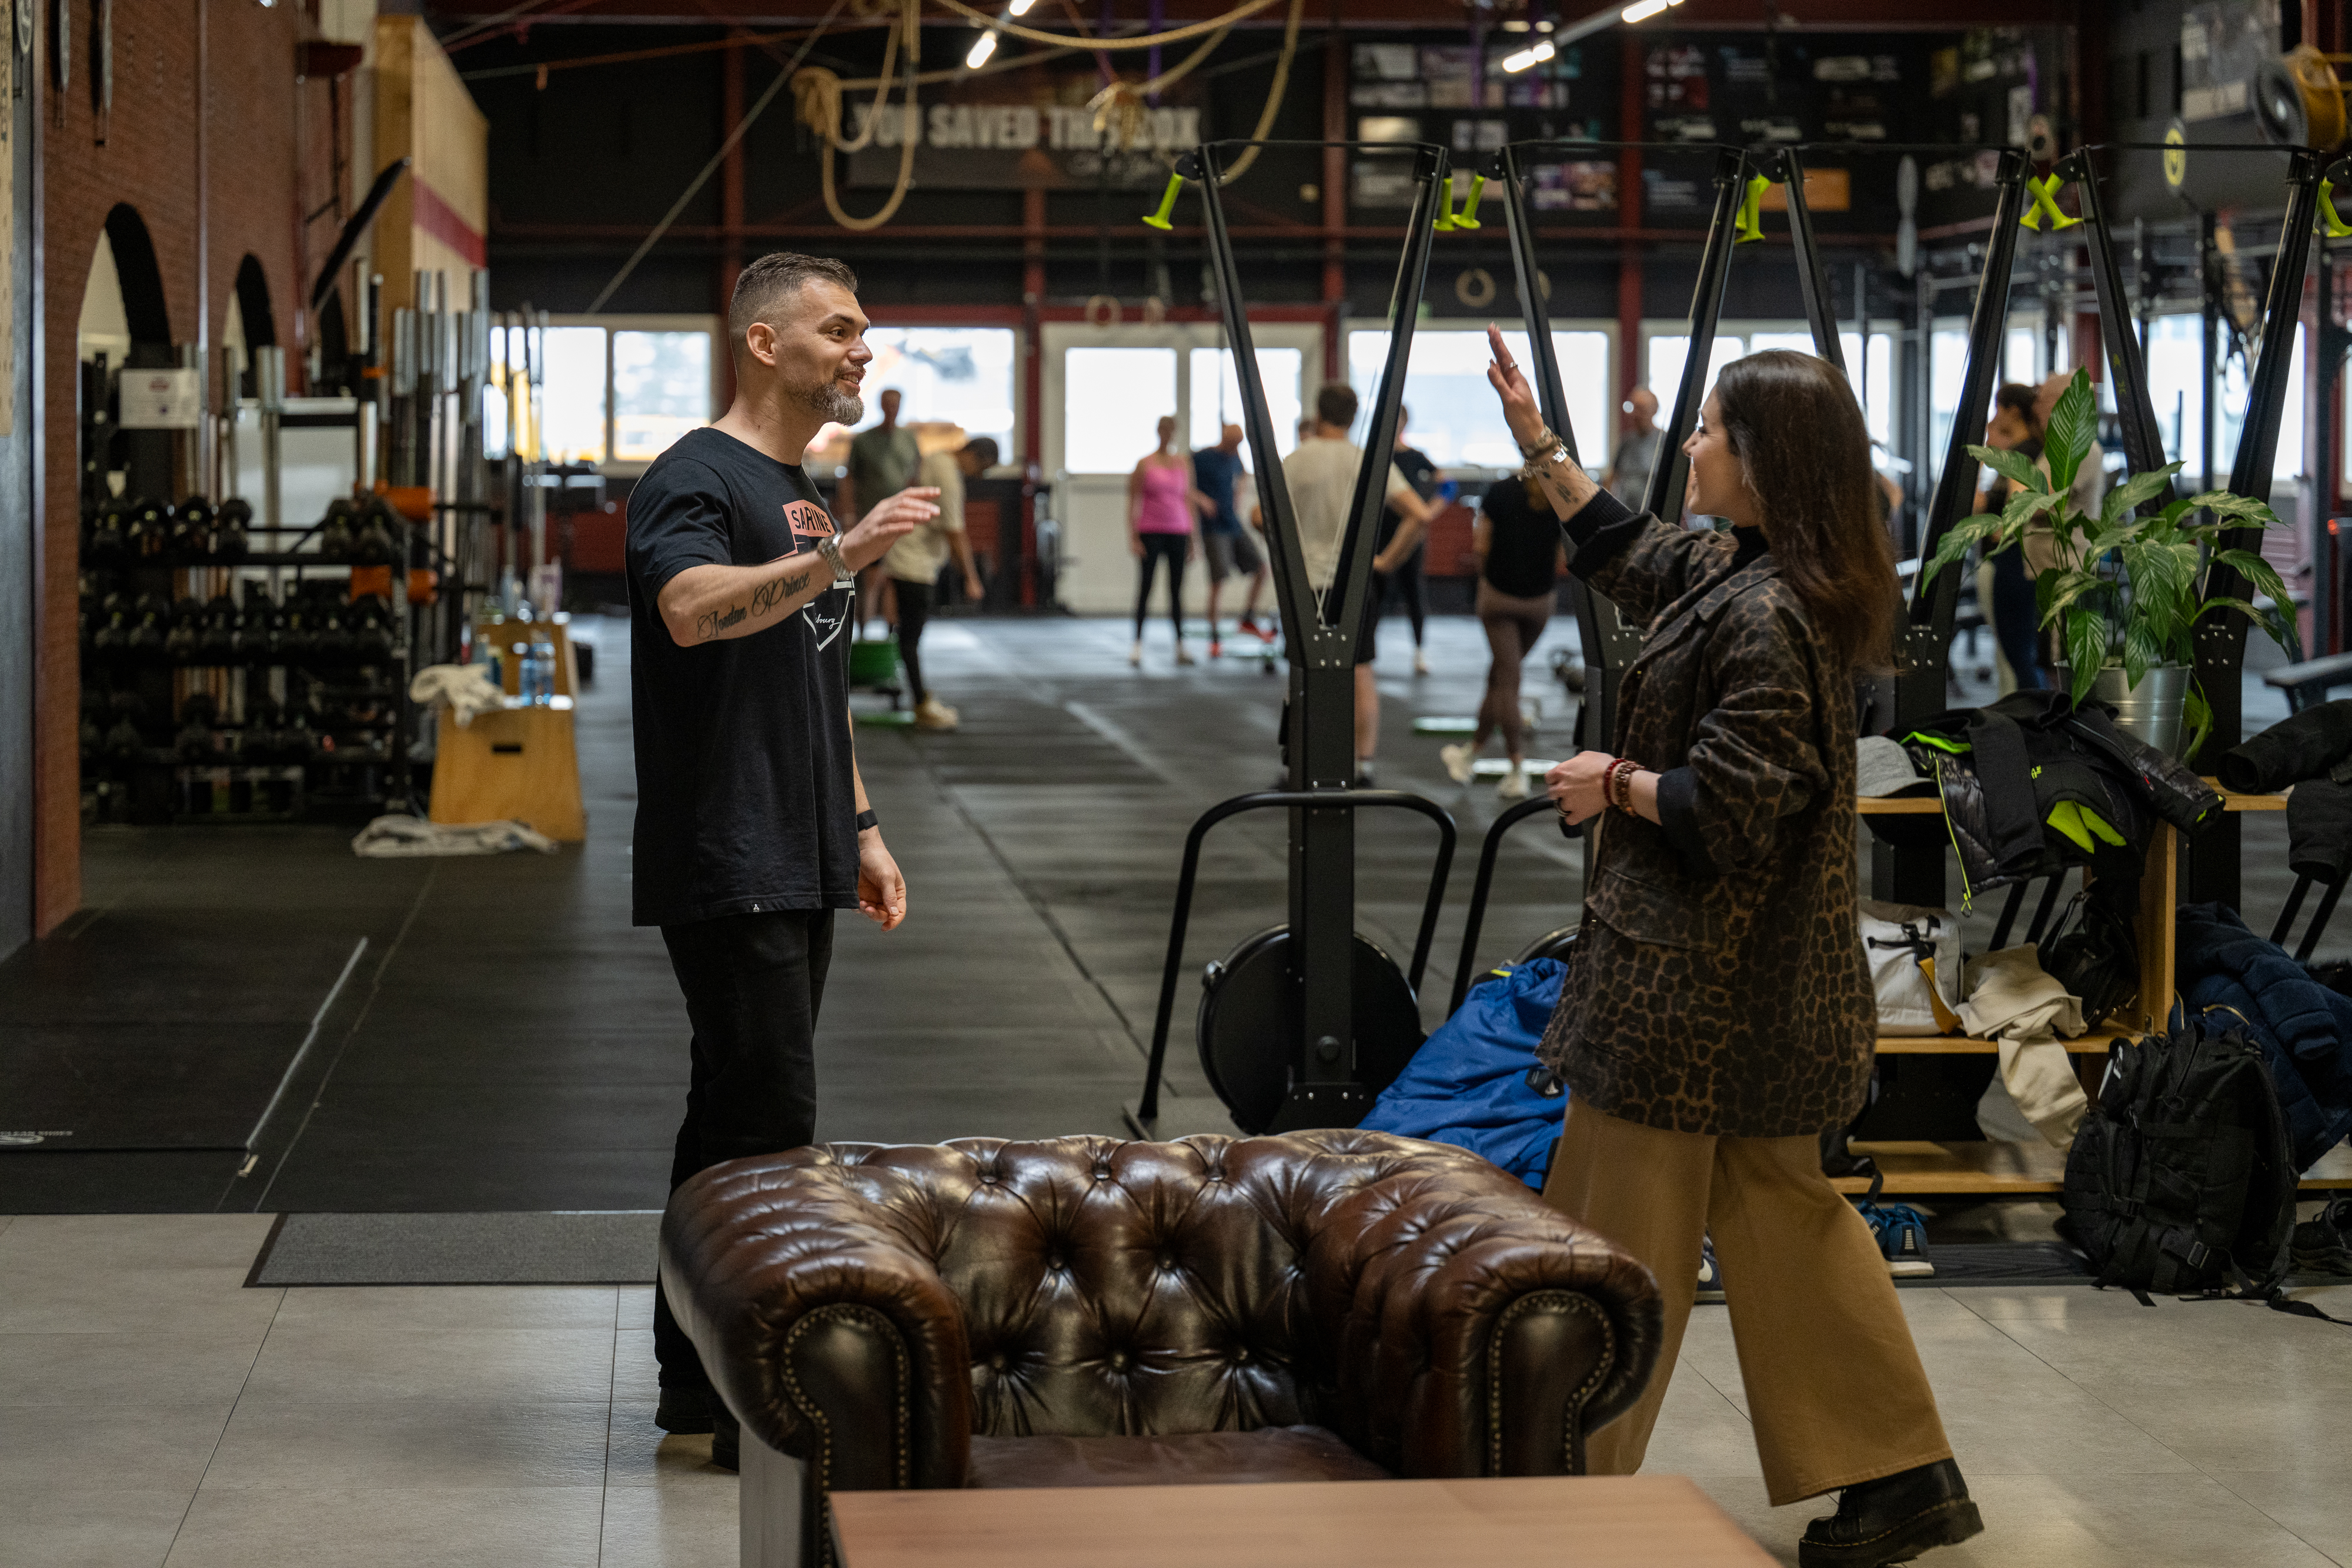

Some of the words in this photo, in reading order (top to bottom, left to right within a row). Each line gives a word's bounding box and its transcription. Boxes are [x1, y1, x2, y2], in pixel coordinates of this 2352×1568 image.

[928, 104, 1040, 149] SAVED
[791, 507, 831, 533] SARINE
[751, 571, 810, 617] Prince
